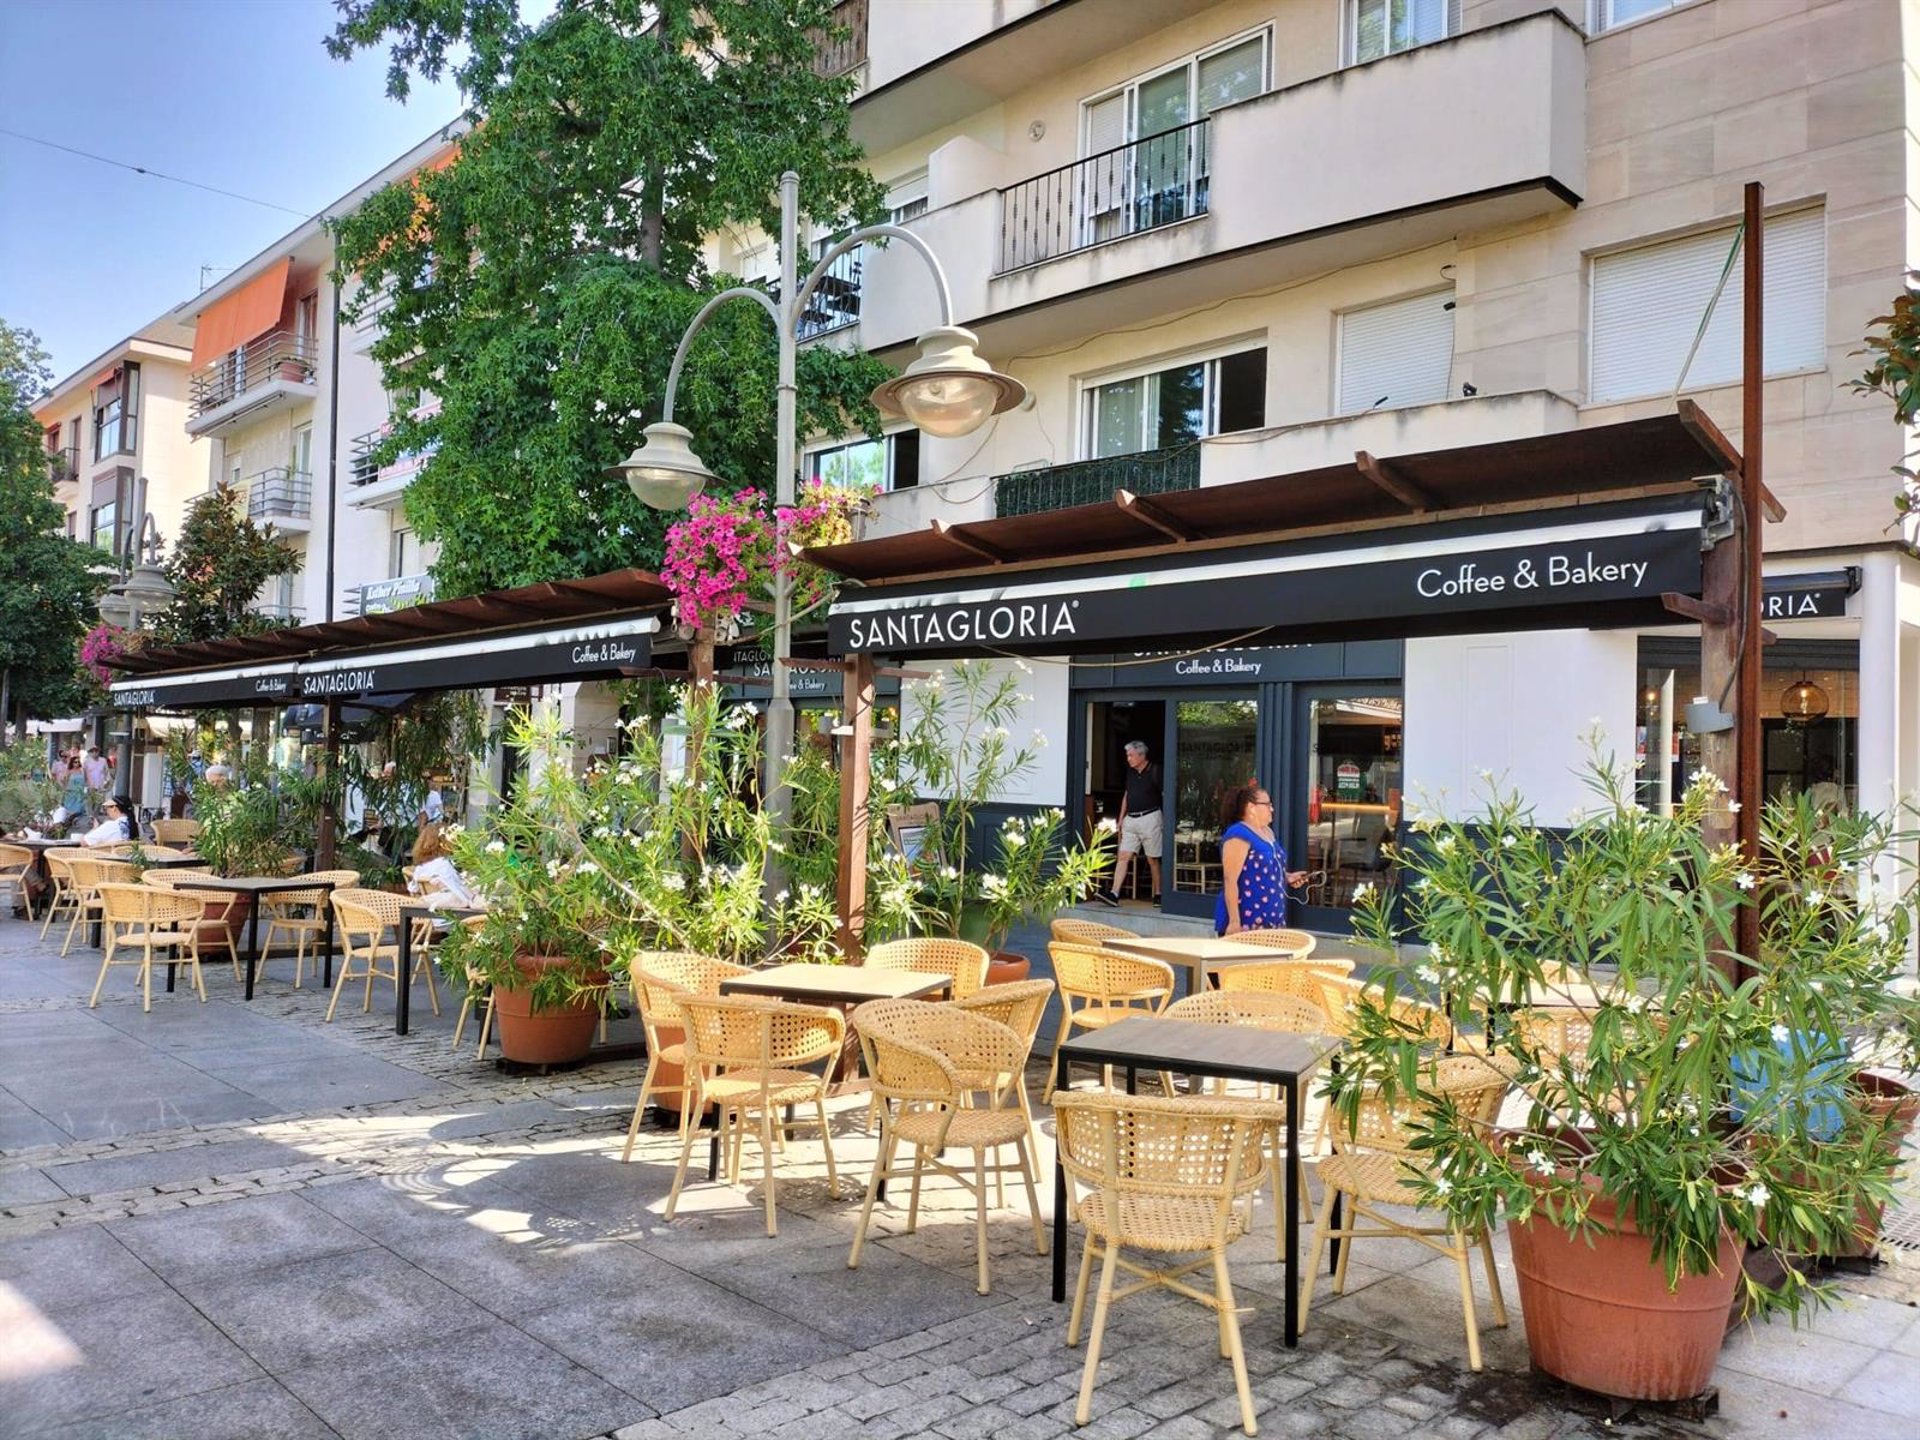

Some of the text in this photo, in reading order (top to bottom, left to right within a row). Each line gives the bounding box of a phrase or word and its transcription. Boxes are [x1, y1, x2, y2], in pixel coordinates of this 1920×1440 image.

[1416, 551, 1648, 598] Coffee & Bakery
[849, 602, 1076, 648] SANTAGLORIA
[572, 643, 637, 663] Coffee & Bakery
[1175, 657, 1261, 675] Coffee & Bakery
[303, 670, 374, 695] SANTAGLORIA
